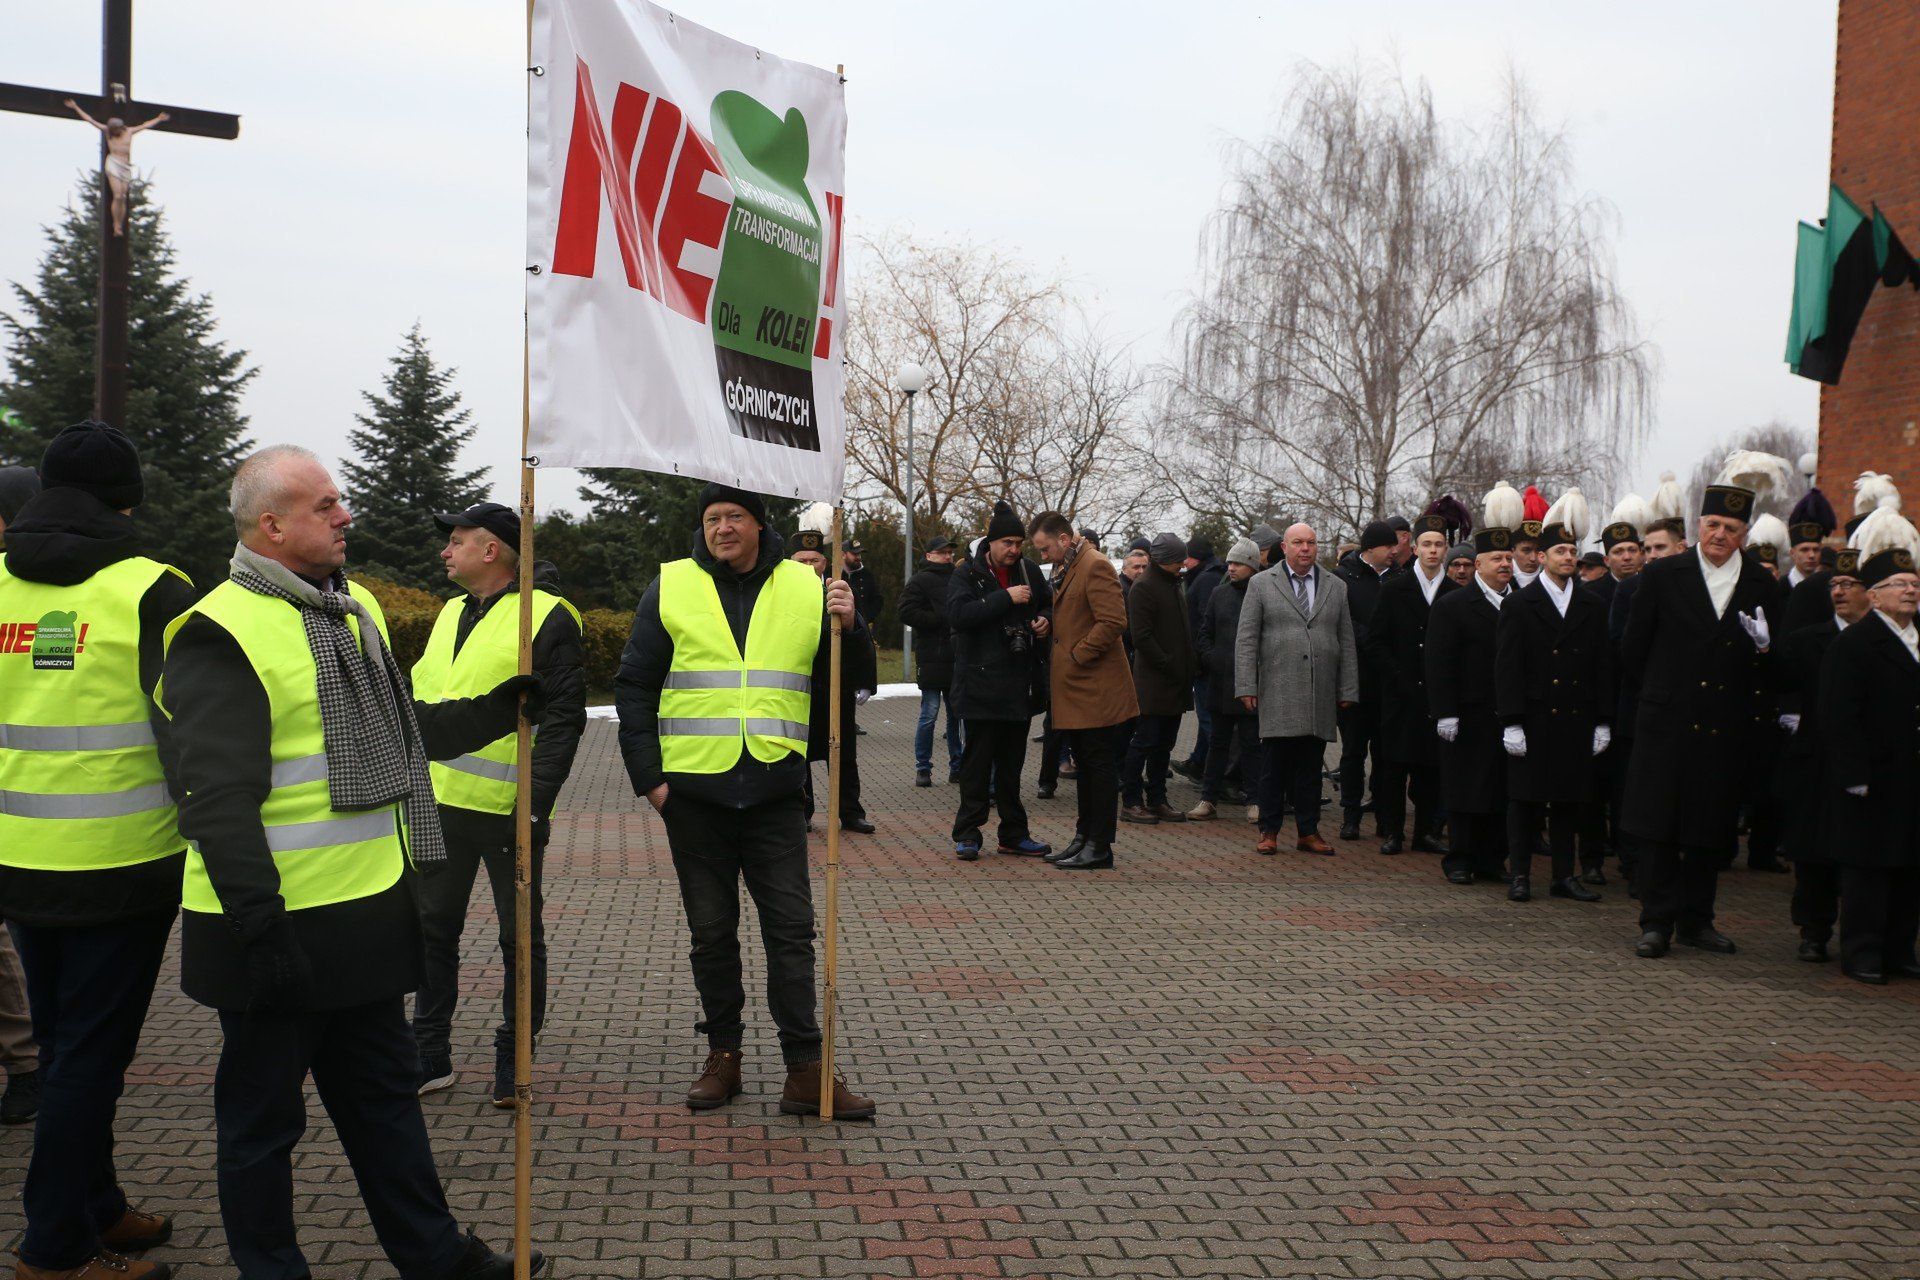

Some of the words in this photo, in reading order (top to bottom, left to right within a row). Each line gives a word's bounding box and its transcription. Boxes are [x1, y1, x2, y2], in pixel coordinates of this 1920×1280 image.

[552, 54, 732, 325] NIE
[733, 206, 819, 266] TRANSFORMACJA
[718, 302, 741, 336] Dla
[756, 305, 810, 354] KOLEI
[725, 376, 810, 427] GÓRNICZYCH
